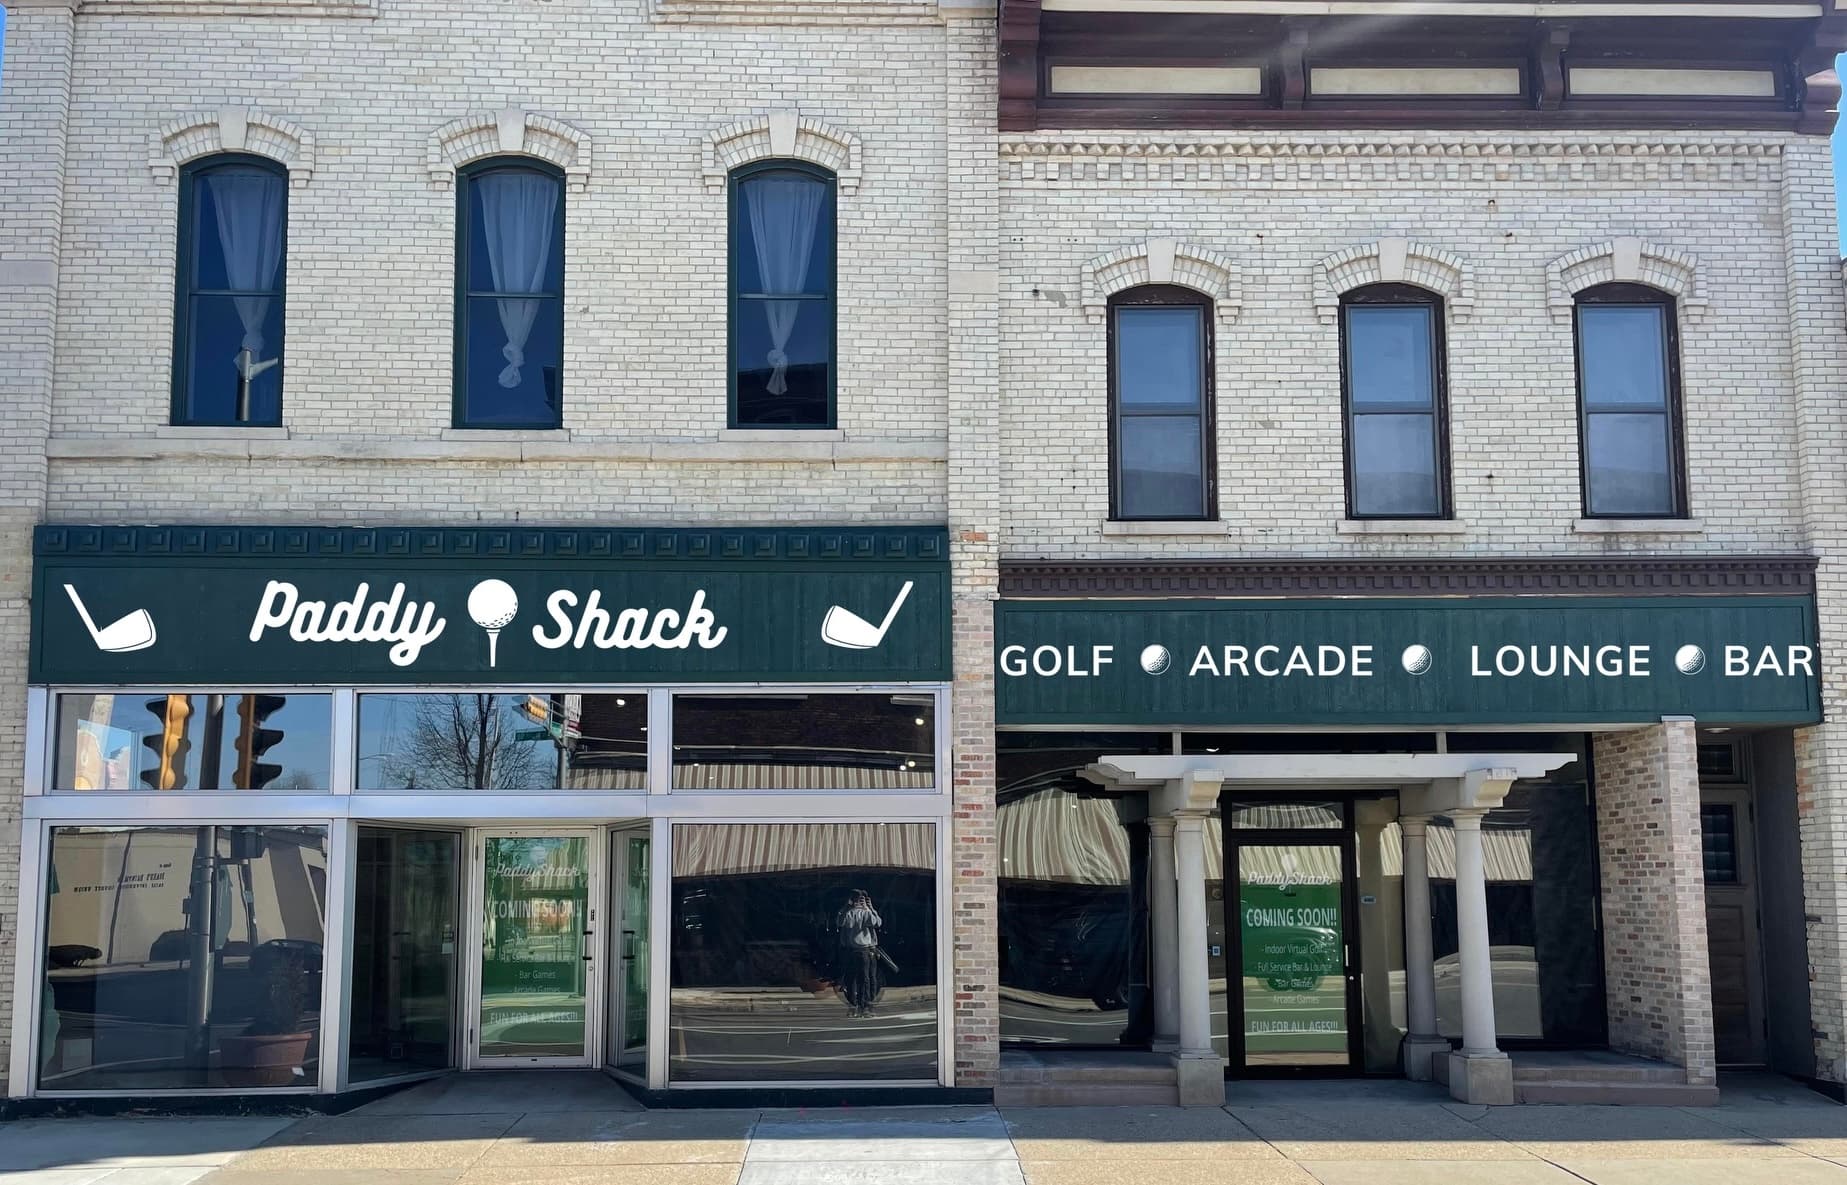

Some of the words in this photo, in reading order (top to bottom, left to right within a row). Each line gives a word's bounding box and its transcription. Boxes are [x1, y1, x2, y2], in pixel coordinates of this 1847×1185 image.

[250, 581, 446, 667] Paddy
[533, 589, 728, 649] Shack
[1000, 645, 1114, 677] GOLF
[1189, 645, 1373, 677] ARCADE
[1471, 645, 1650, 677] LOUNGE
[1725, 645, 1814, 676] BAR
[495, 863, 540, 881] Paddy
[1247, 871, 1291, 890] Paddy
[1291, 871, 1333, 886] Shack
[1246, 908, 1294, 927] COMING
[1297, 908, 1337, 926] SOON!!
[1265, 944, 1286, 954] Indoor
[1287, 944, 1309, 954] Virtual
[519, 970, 531, 979] Bar
[532, 970, 556, 979] Games
[1257, 962, 1269, 972] Full
[1270, 962, 1292, 972] Service
[1292, 962, 1302, 972] Bar
[1252, 1020, 1270, 1033] FUN
[1272, 1020, 1289, 1033] FOR
[1291, 1020, 1307, 1033] ALL
[1308, 1019, 1338, 1033] AGES!!!
